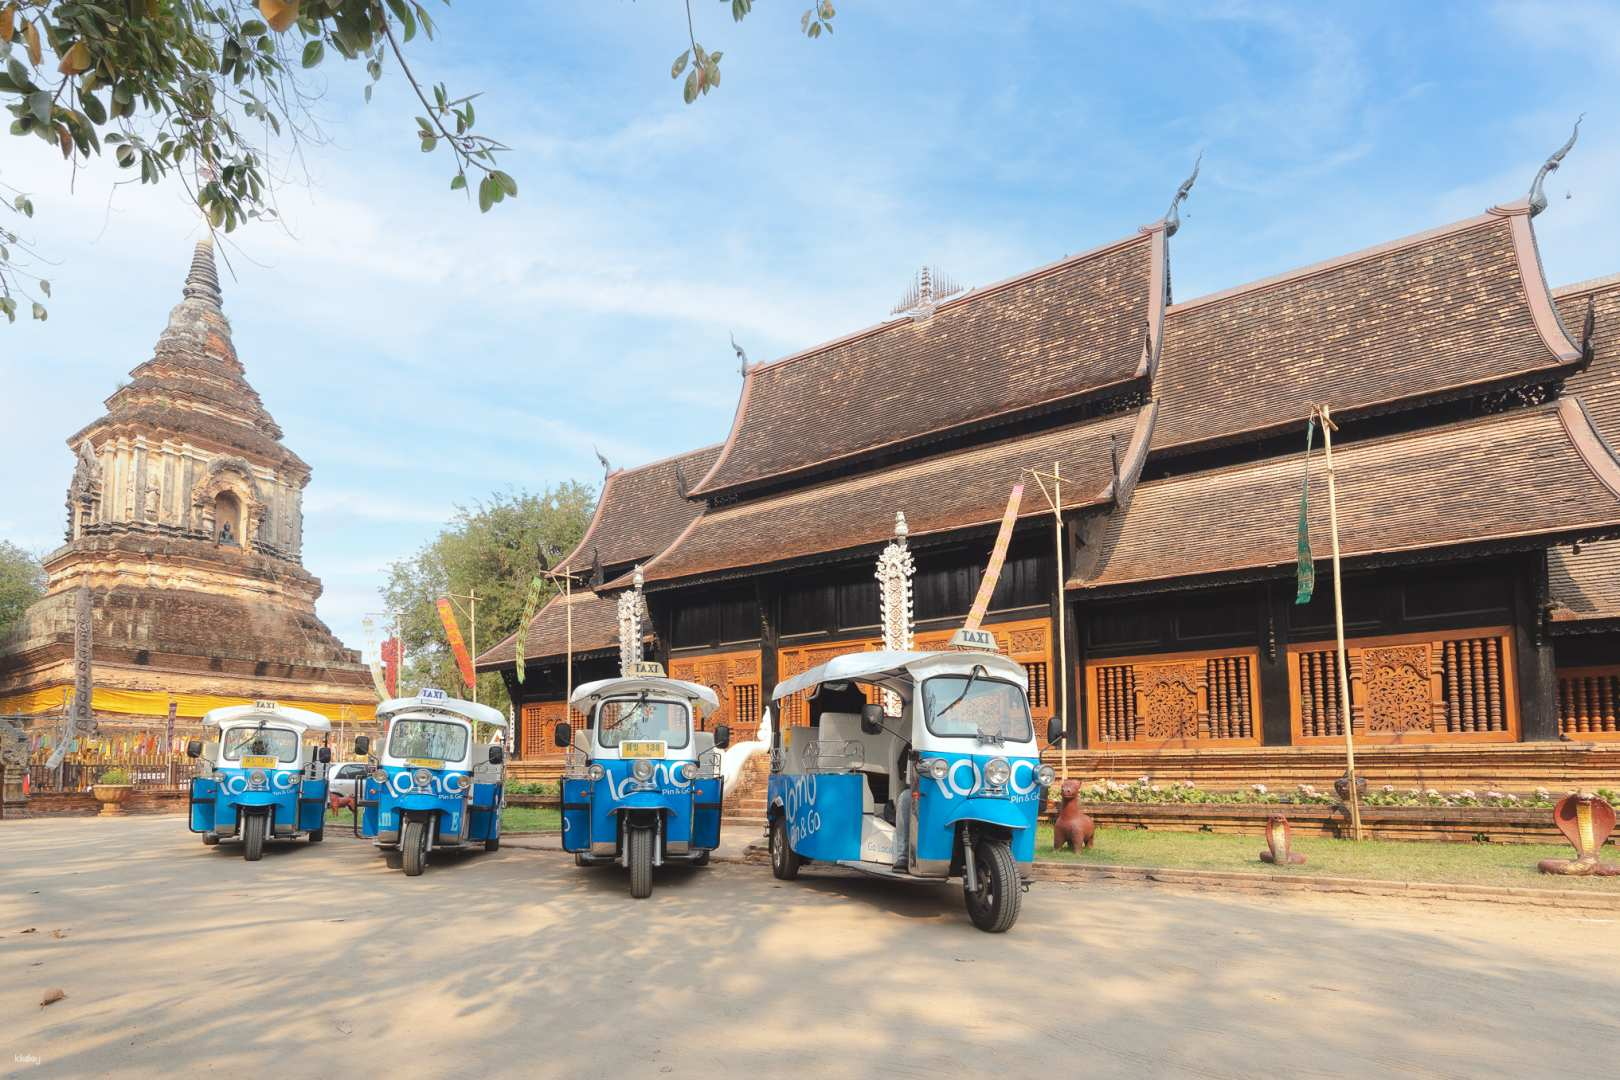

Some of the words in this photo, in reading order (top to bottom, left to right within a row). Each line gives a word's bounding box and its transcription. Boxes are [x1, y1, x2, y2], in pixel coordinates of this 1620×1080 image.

[961, 630, 989, 644] TAXI
[634, 664, 659, 673] TAXI
[422, 689, 443, 699] TAXI
[256, 701, 275, 709] TAXI
[800, 817, 807, 840] &
[808, 809, 821, 834] Go
